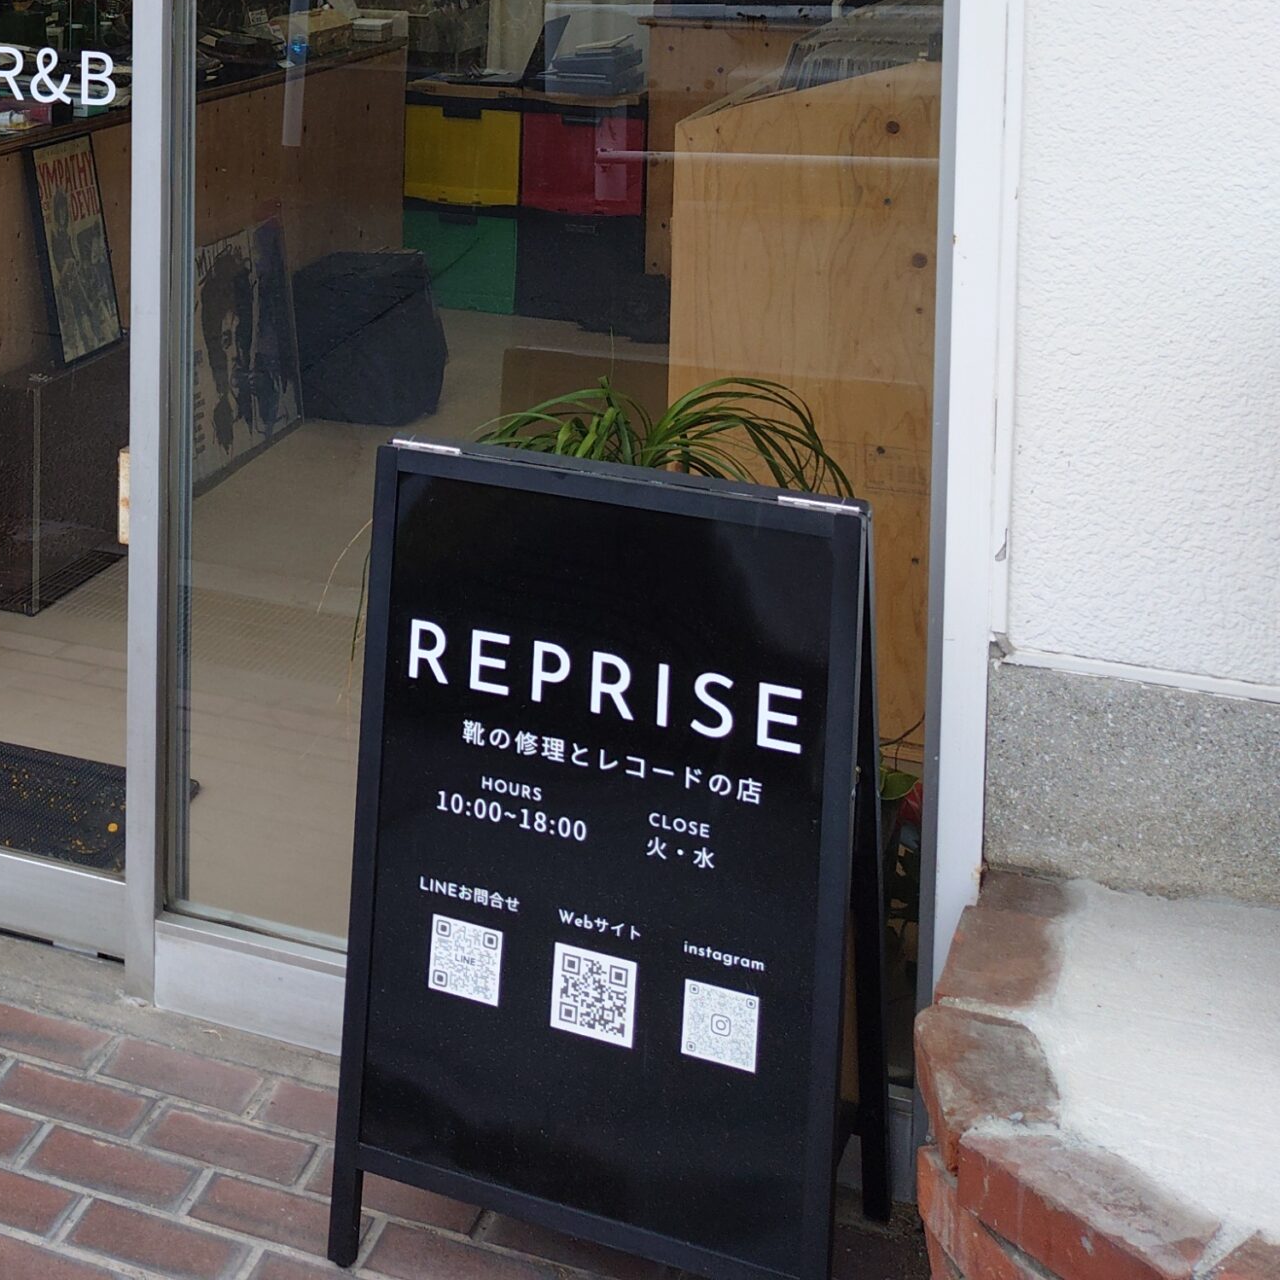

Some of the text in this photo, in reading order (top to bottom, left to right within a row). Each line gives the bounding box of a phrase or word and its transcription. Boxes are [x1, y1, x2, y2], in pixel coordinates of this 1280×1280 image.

[408, 618, 803, 754] REPRISE
[462, 718, 763, 805] 靴の修理とレコードの店
[481, 776, 542, 801] HOURS
[648, 812, 710, 839] CLOSE
[646, 836, 715, 870] 火・水
[419, 875, 521, 913] LINEお問合せ
[558, 908, 642, 941] Webサイト
[454, 952, 477, 967] LINE
[683, 940, 766, 972] instagram
